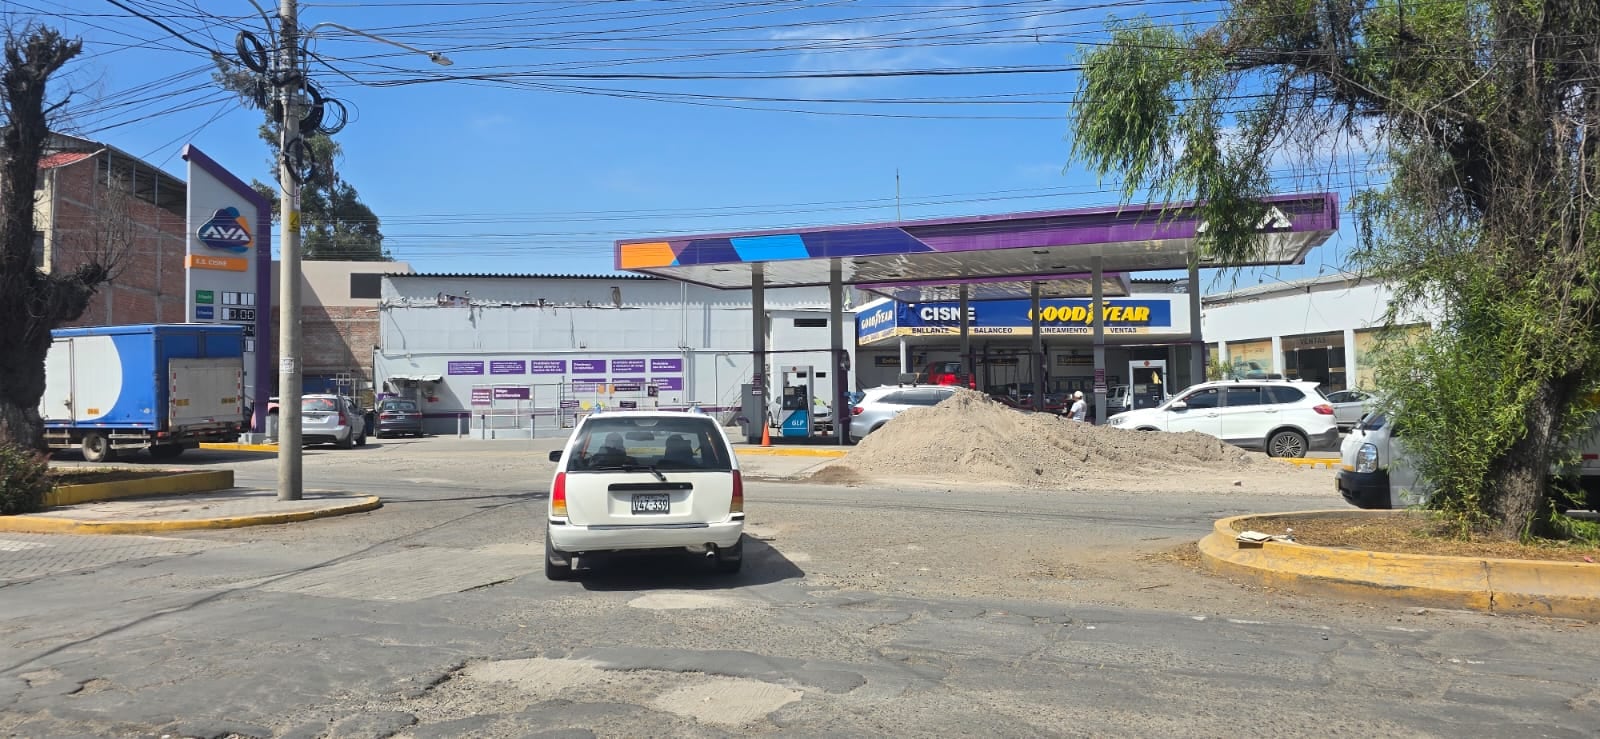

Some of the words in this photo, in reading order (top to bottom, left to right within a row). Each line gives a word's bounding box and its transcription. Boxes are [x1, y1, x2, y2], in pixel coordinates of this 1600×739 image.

[204, 226, 250, 241] AVA
[861, 309, 893, 329] GOODYEAR
[920, 306, 976, 321] CISNE
